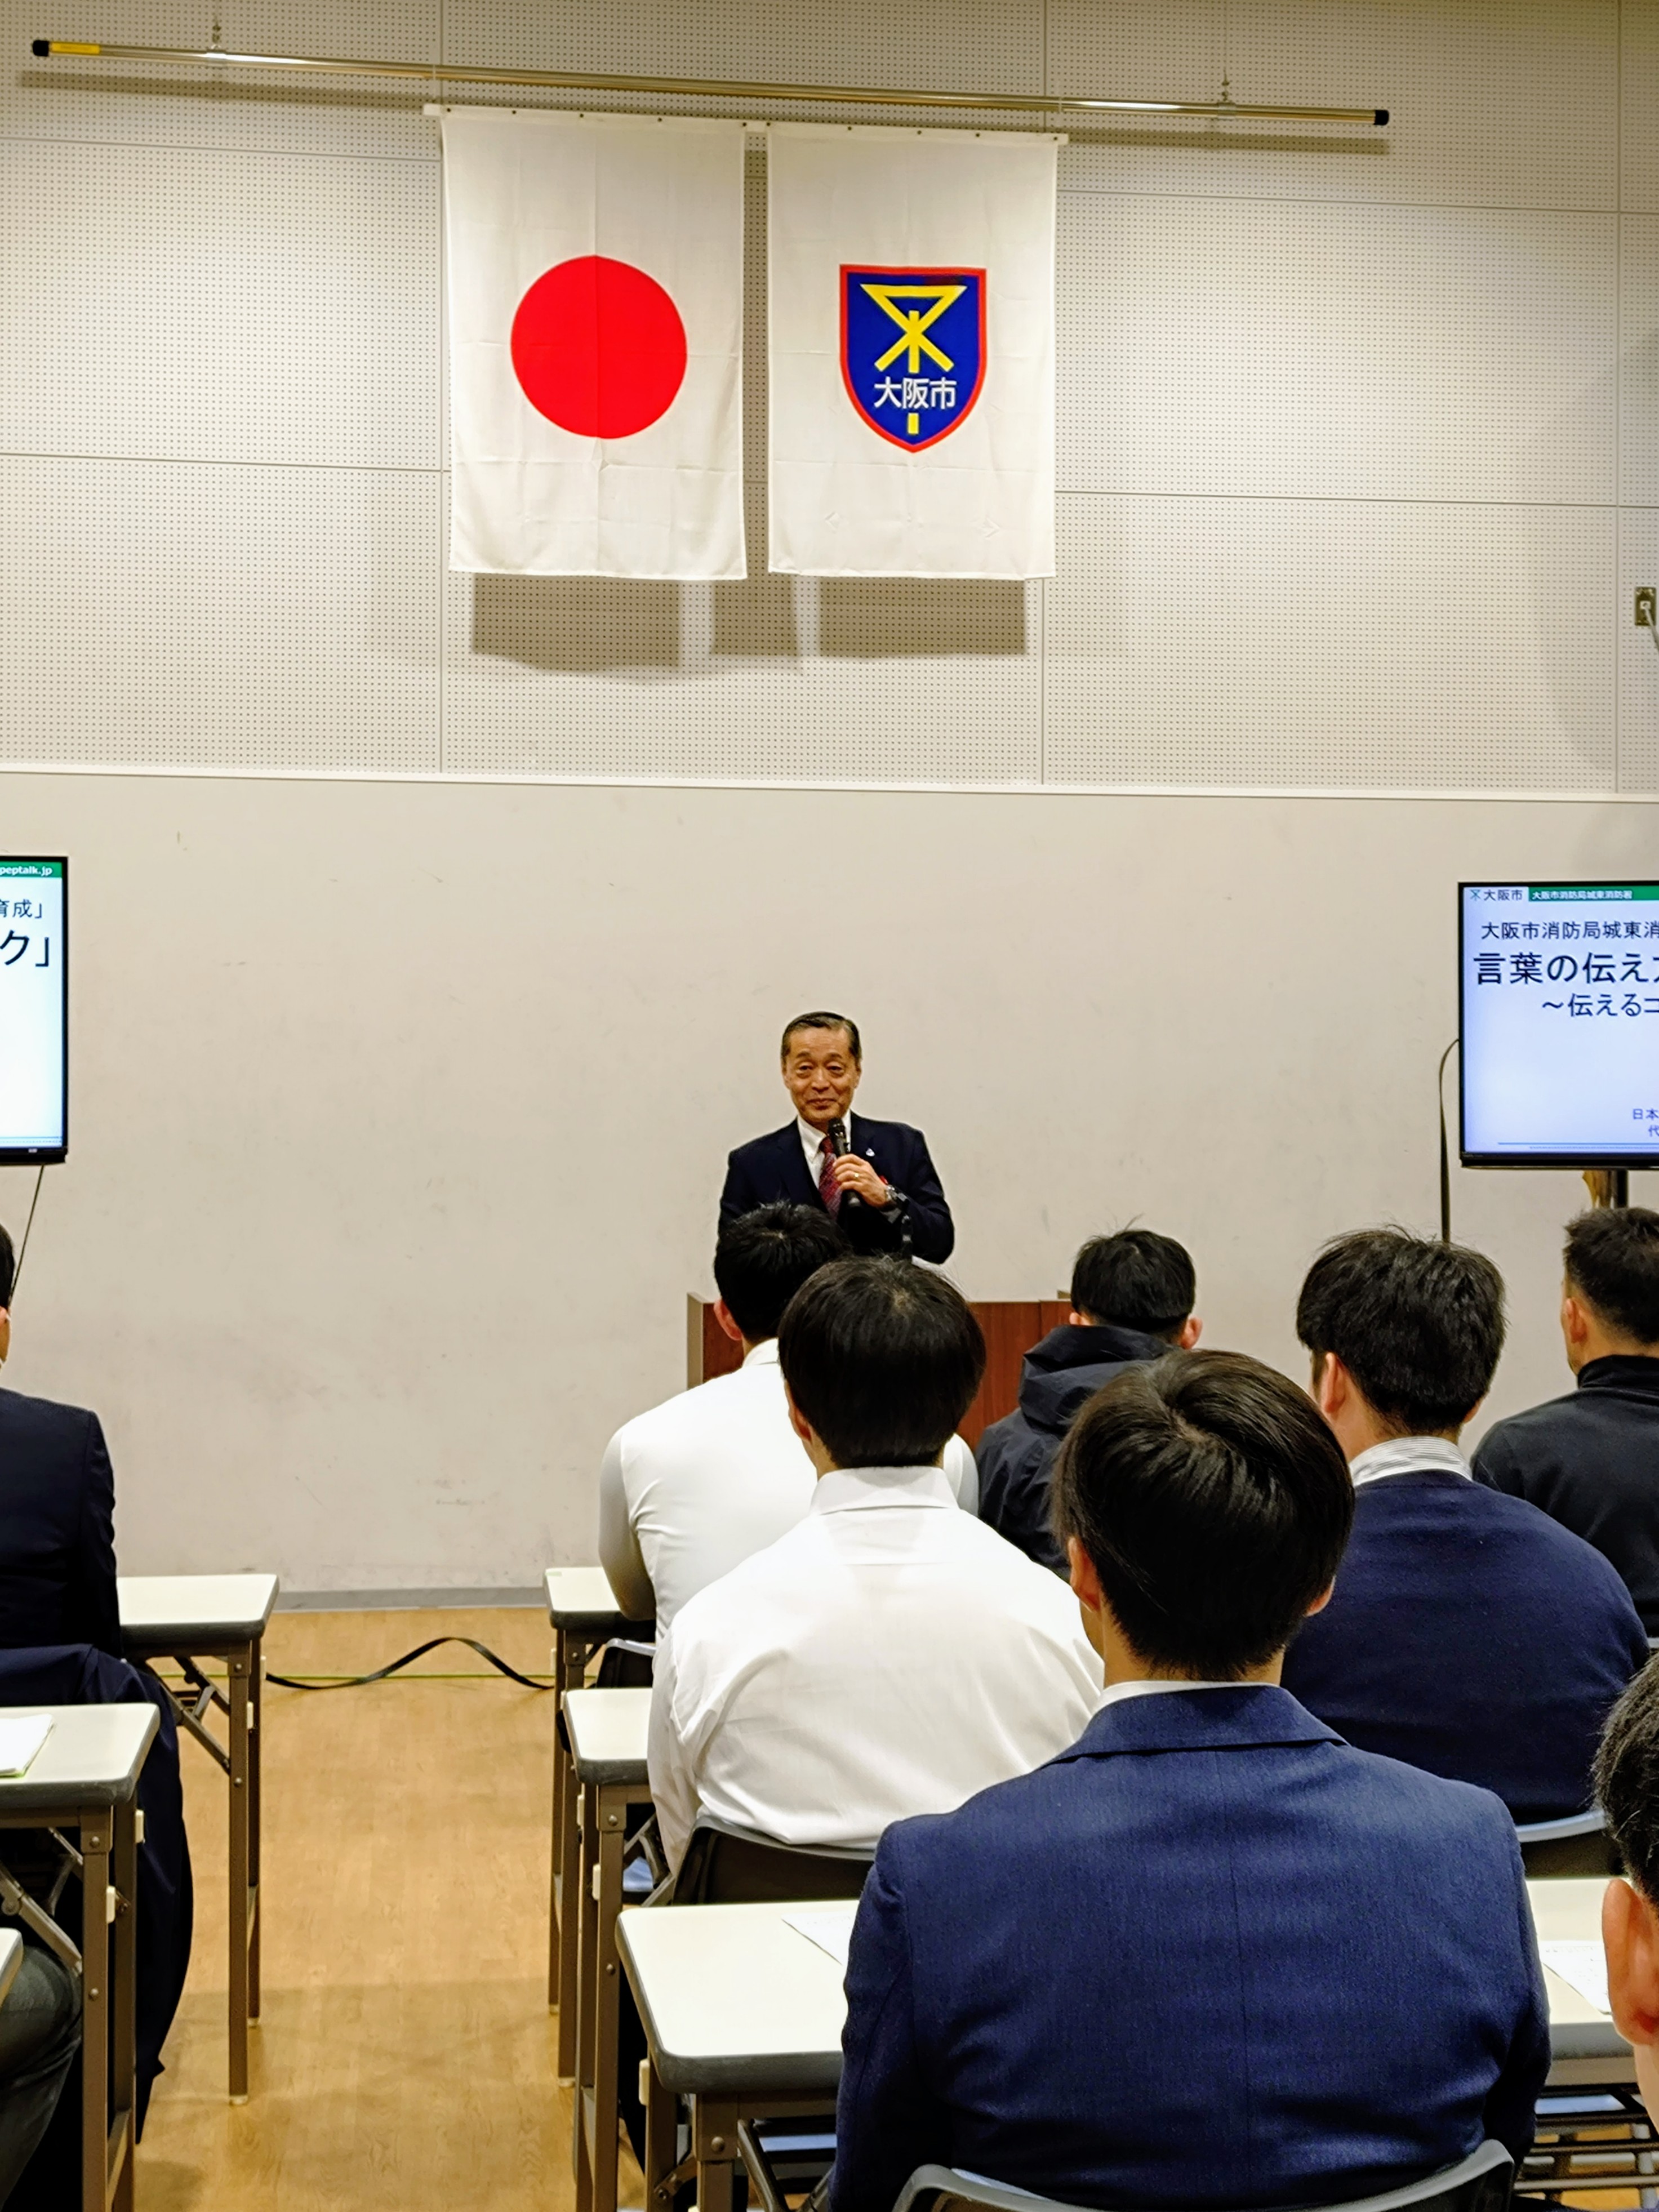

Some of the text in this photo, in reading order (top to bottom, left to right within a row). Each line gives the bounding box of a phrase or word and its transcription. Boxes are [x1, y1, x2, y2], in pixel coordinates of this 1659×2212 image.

[874, 376, 957, 410] 大阪市
[0, 866, 52, 876] peptalk.jp
[1483, 889, 1523, 901] 大阪市
[1481, 920, 1659, 940] 大阪市消防局城東消
[1473, 952, 1659, 985] 言葉の伝え
[1633, 1108, 1659, 1121] 日本
